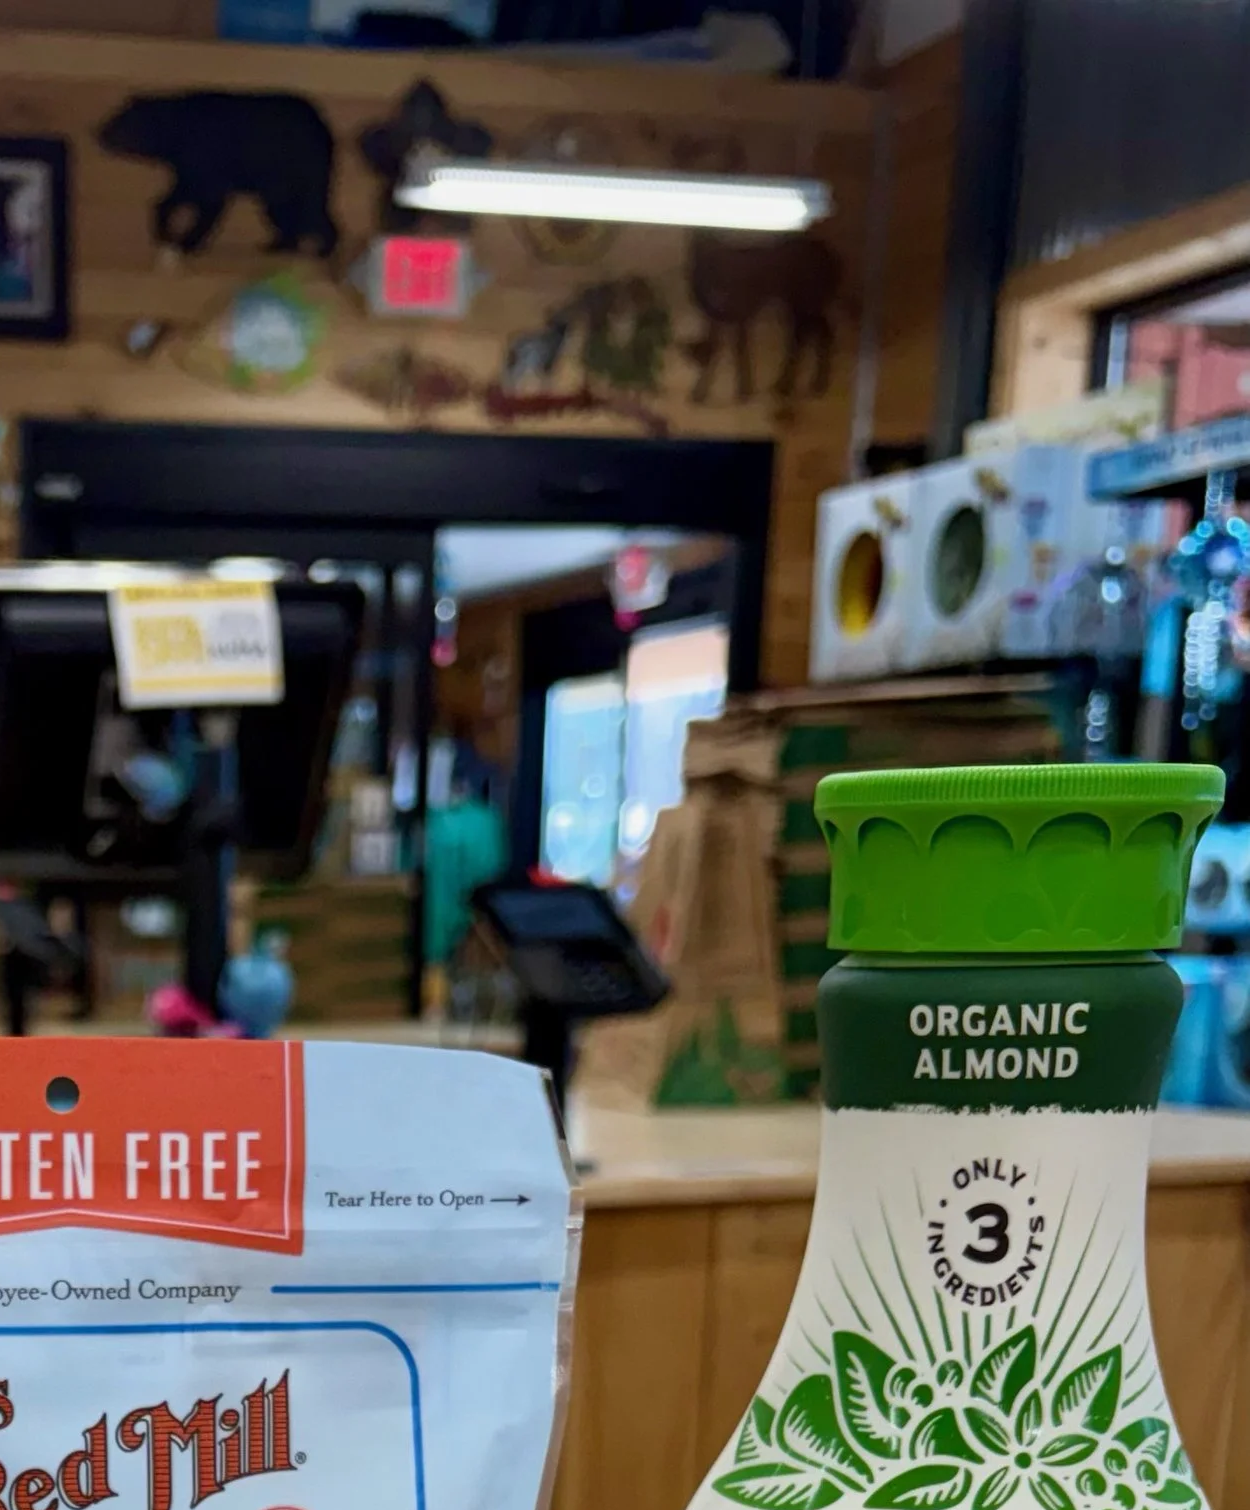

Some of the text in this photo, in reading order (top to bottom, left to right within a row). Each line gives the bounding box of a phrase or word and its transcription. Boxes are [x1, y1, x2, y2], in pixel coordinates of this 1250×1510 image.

[910, 1002, 1090, 1036] ORGANIC
[913, 1047, 1079, 1079] ALMOND
[125, 1131, 261, 1201] FREE
[952, 1157, 1027, 1190] ONLY
[325, 1190, 484, 1212] Tear Here to Open
[962, 1203, 1009, 1264] 3
[928, 1216, 1045, 1307] INGREDIENTS
[137, 1279, 242, 1310] Company
